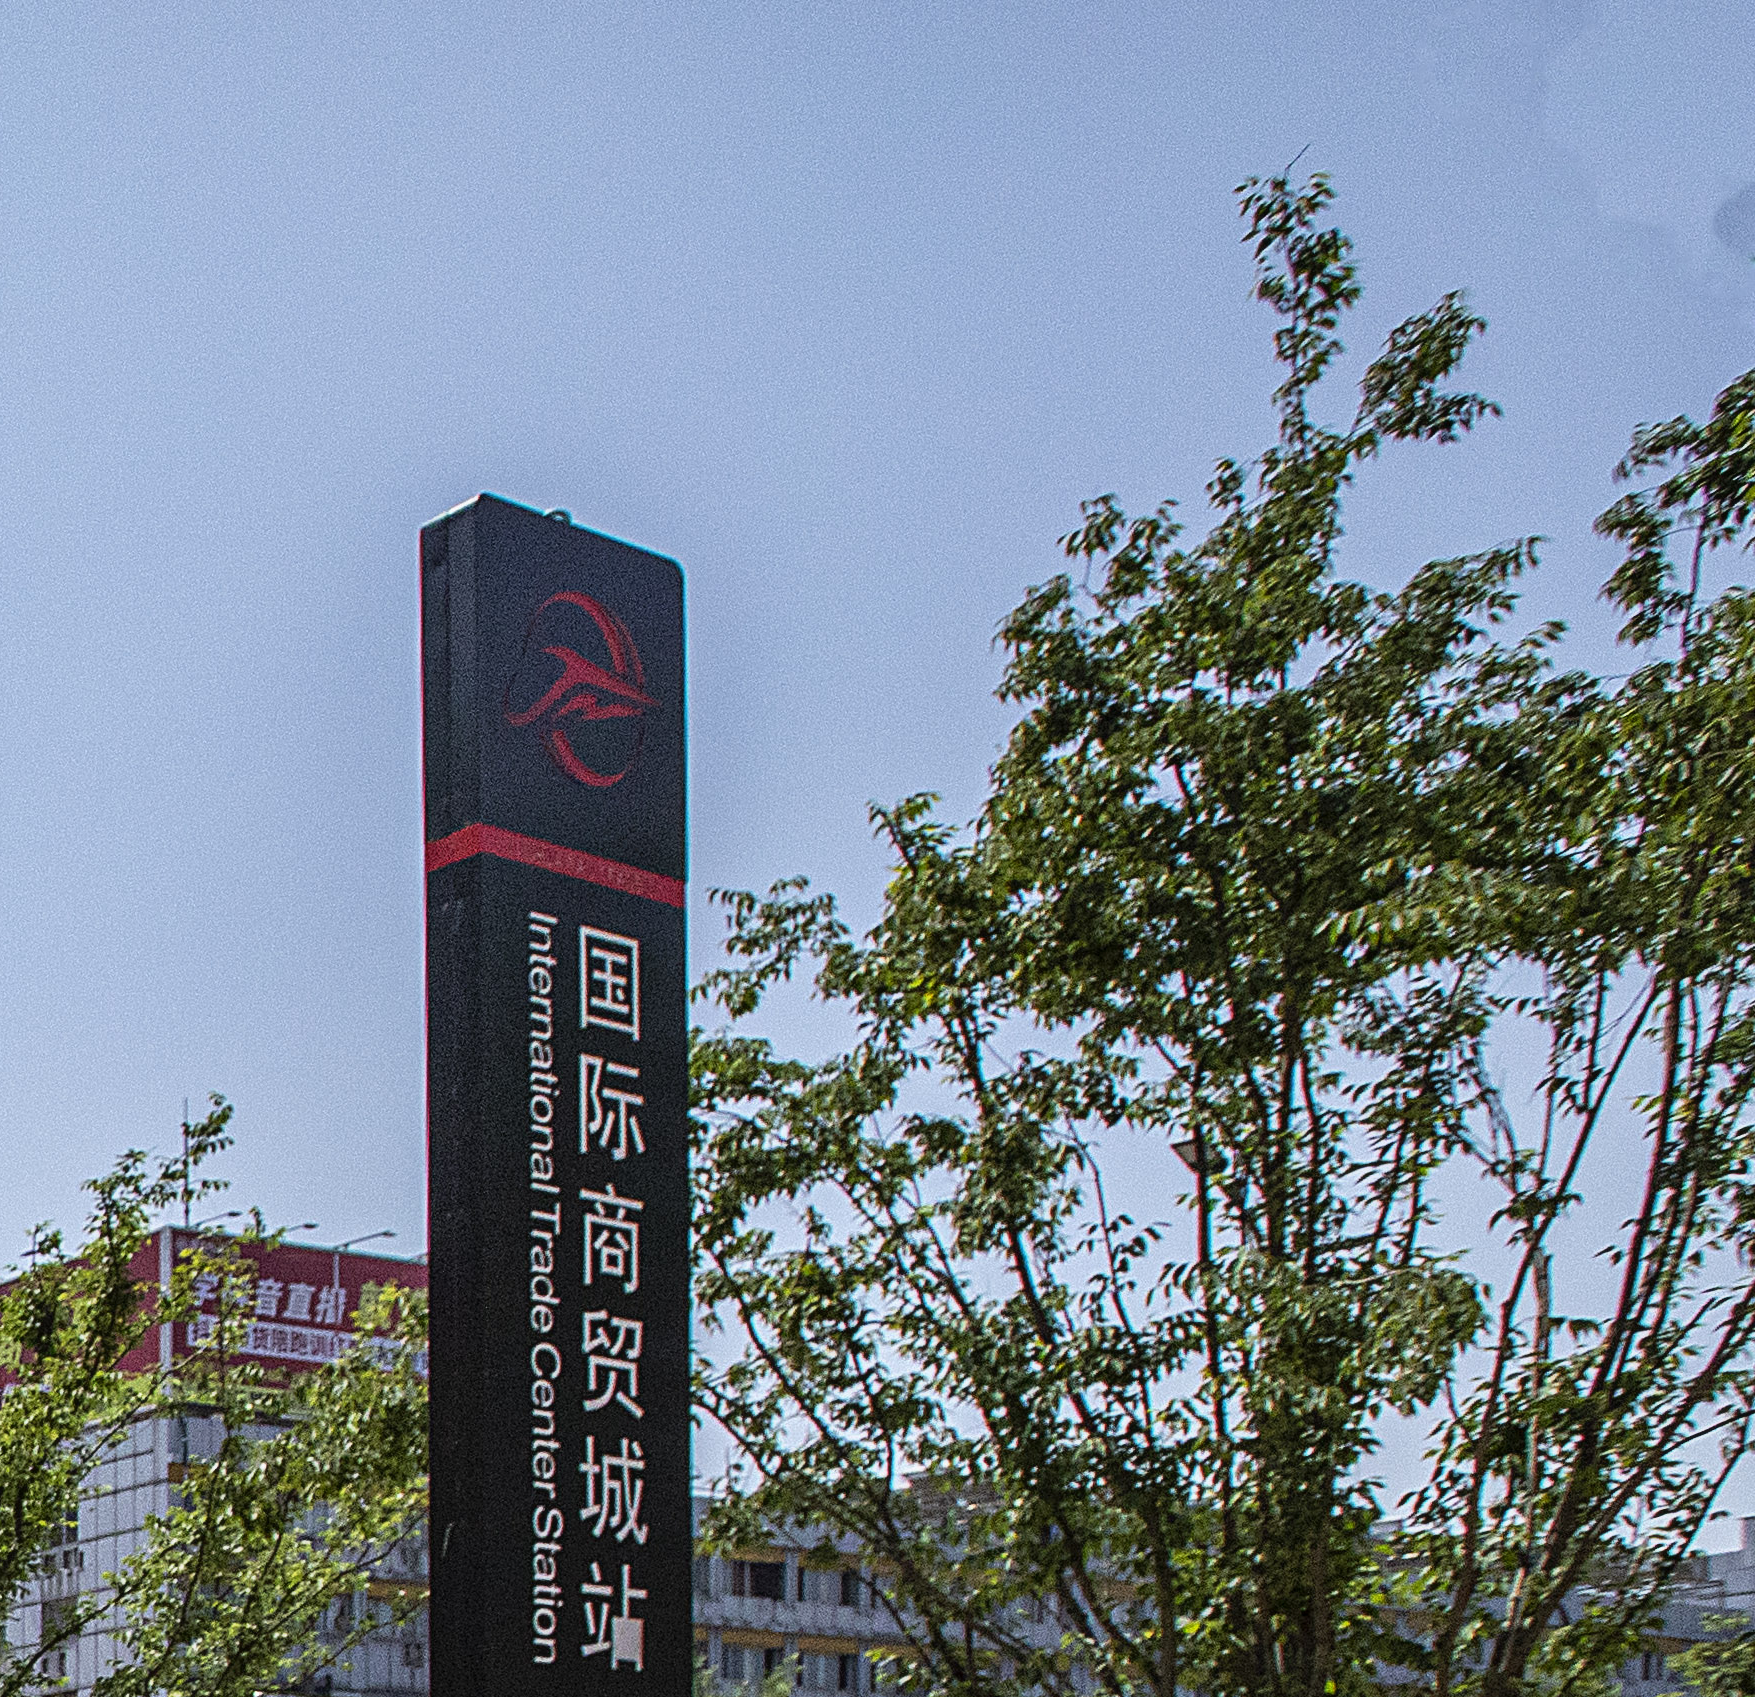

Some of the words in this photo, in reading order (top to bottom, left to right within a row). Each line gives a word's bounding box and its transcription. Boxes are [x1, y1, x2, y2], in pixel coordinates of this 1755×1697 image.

[527, 909, 563, 1198] International
[530, 1202, 563, 1334] Trade
[578, 923, 649, 1673] 国际商贸城站
[530, 1340, 563, 1499] Center
[531, 1505, 566, 1666] Station
